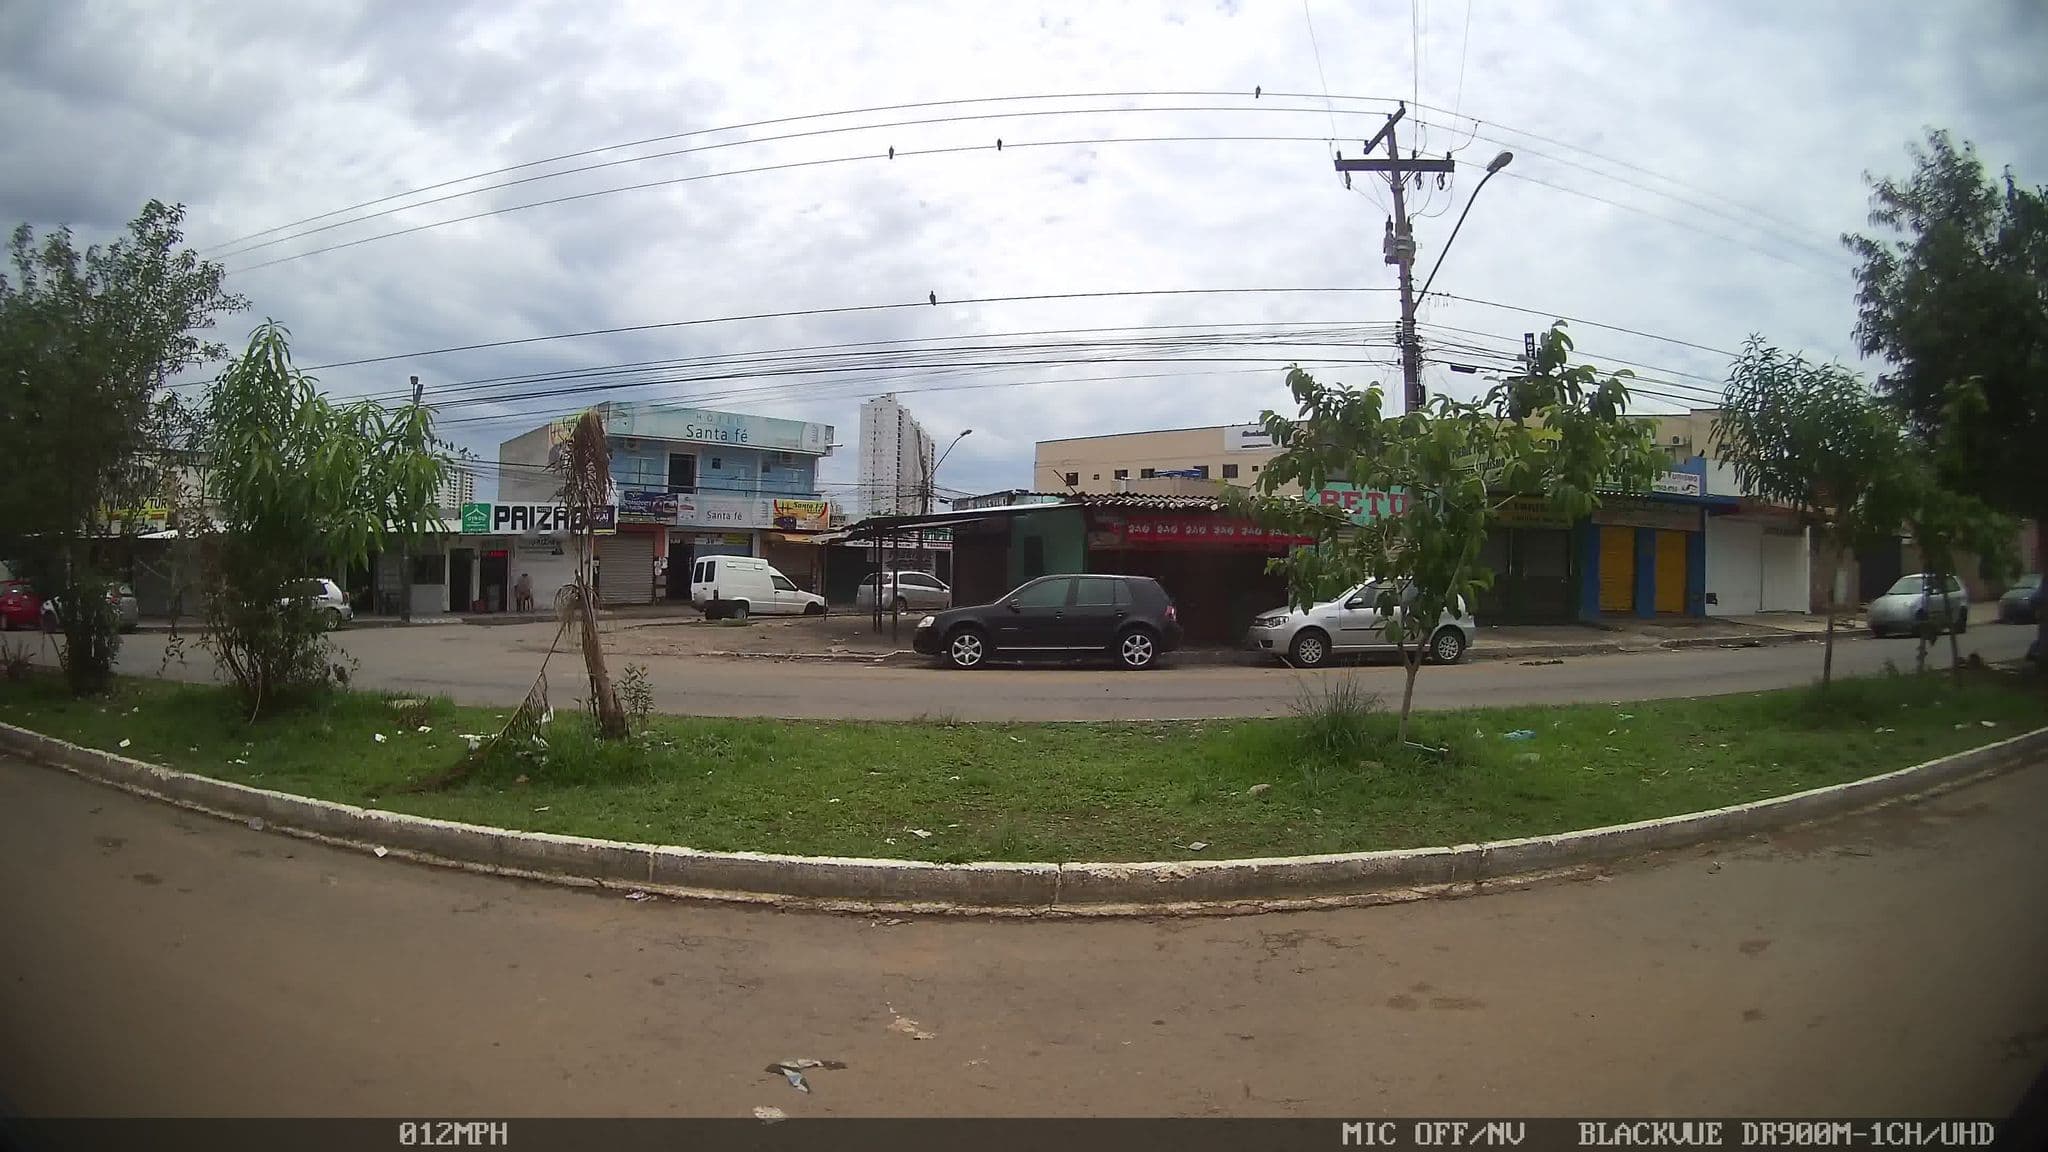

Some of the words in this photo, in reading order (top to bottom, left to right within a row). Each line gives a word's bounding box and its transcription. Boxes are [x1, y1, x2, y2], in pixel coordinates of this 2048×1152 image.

[686, 424, 728, 441] Santa
[735, 427, 748, 443] fé
[706, 510, 731, 521] Santa
